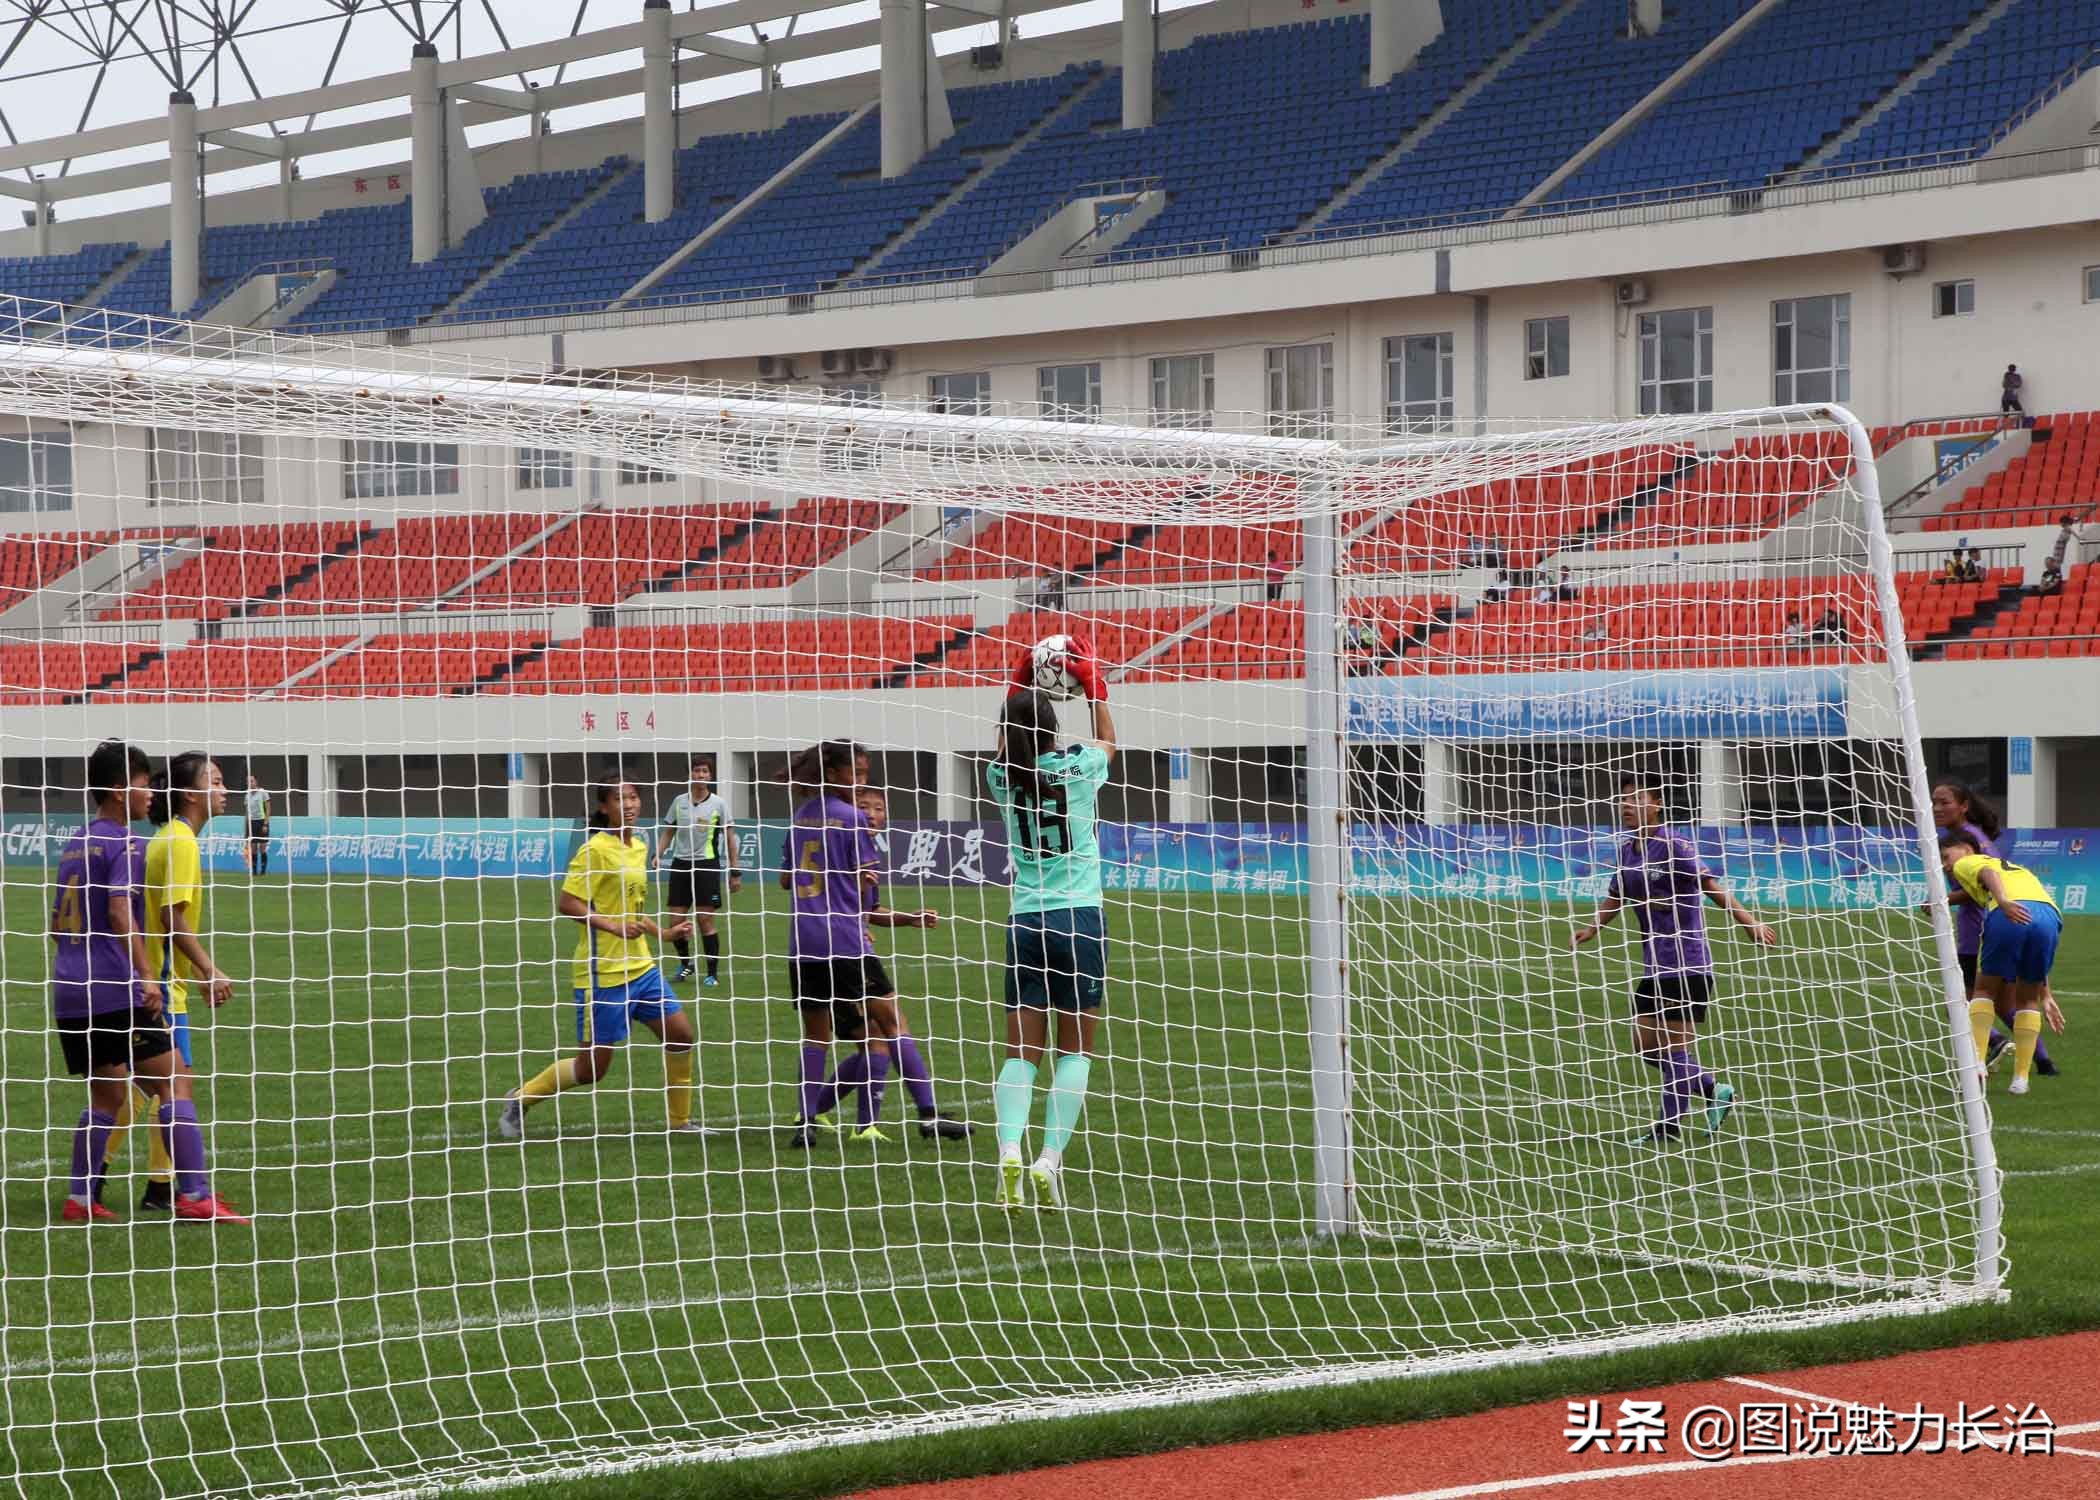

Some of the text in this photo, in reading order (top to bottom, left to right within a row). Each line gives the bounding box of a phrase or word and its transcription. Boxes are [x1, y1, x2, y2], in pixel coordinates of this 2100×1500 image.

[6, 824, 46, 856] CFA
[797, 840, 823, 898] 5
[59, 874, 82, 945] 4
